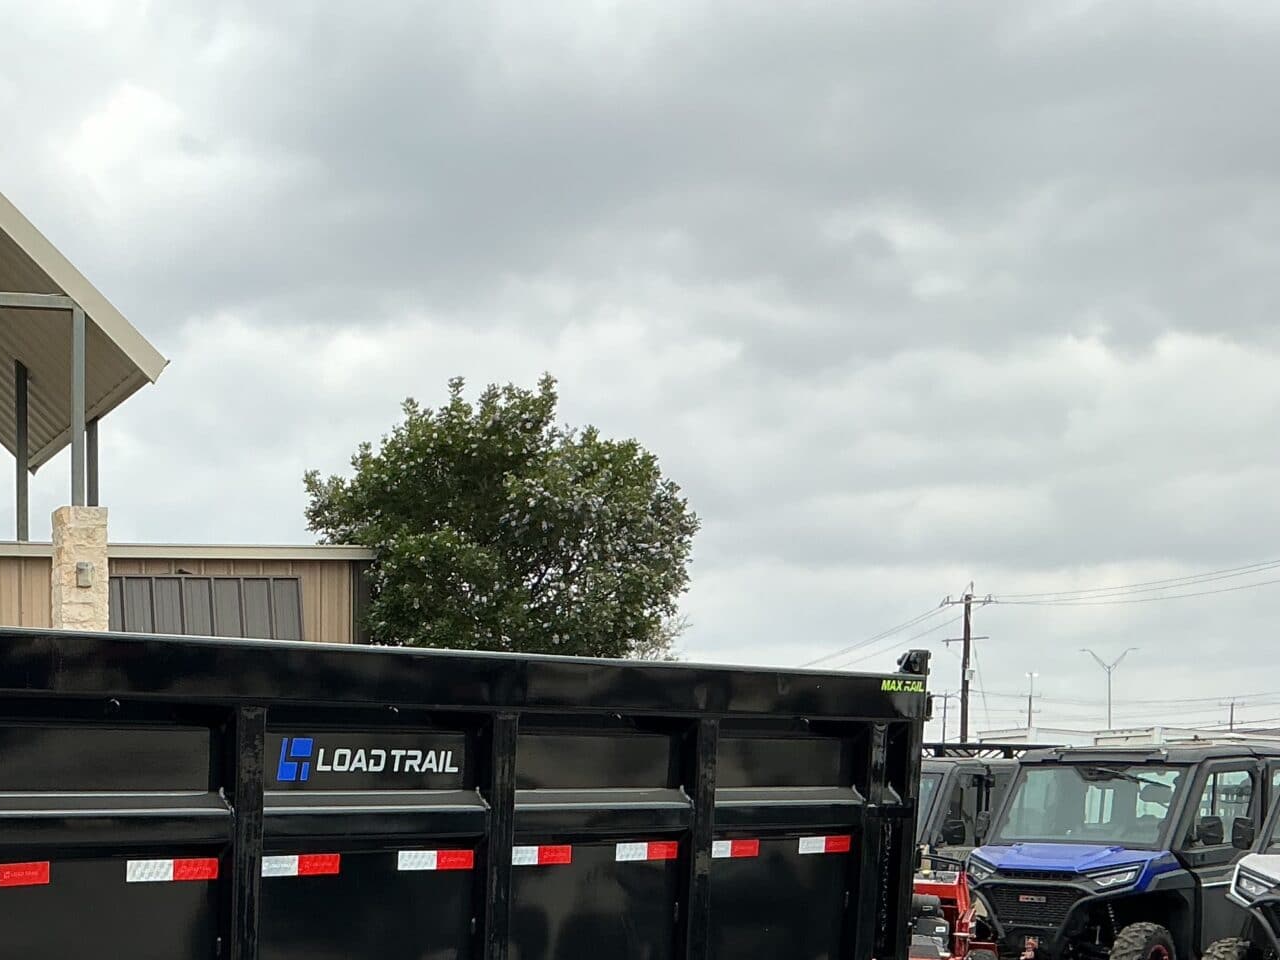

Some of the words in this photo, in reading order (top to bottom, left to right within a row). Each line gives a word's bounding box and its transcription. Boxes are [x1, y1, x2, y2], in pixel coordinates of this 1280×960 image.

[881, 680, 904, 691] MAX
[904, 681, 924, 692] RAIL
[316, 749, 387, 772] LOAD
[391, 750, 459, 773] TRAIL
